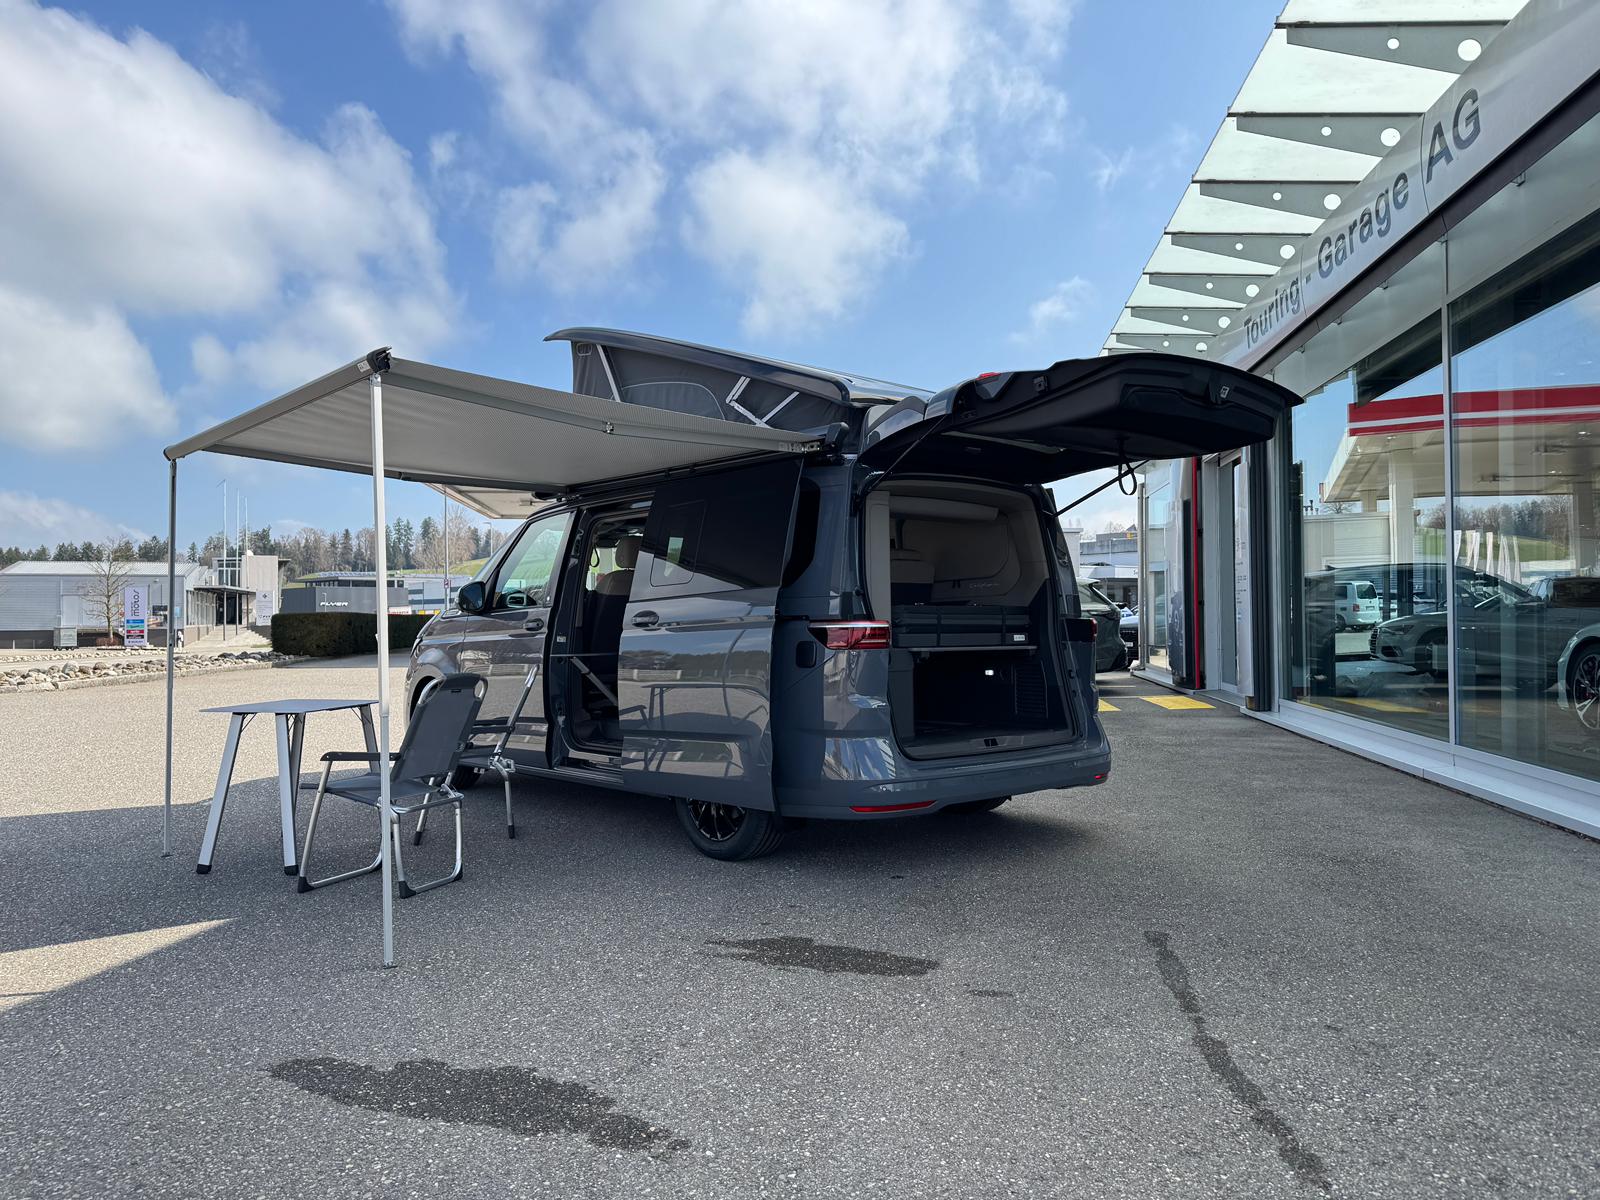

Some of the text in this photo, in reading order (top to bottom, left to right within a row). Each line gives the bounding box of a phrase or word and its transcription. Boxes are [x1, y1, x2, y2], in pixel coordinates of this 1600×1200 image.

[1244, 277, 1300, 349] Touring
[1318, 172, 1409, 279] Garage
[1425, 88, 1481, 184] AG
